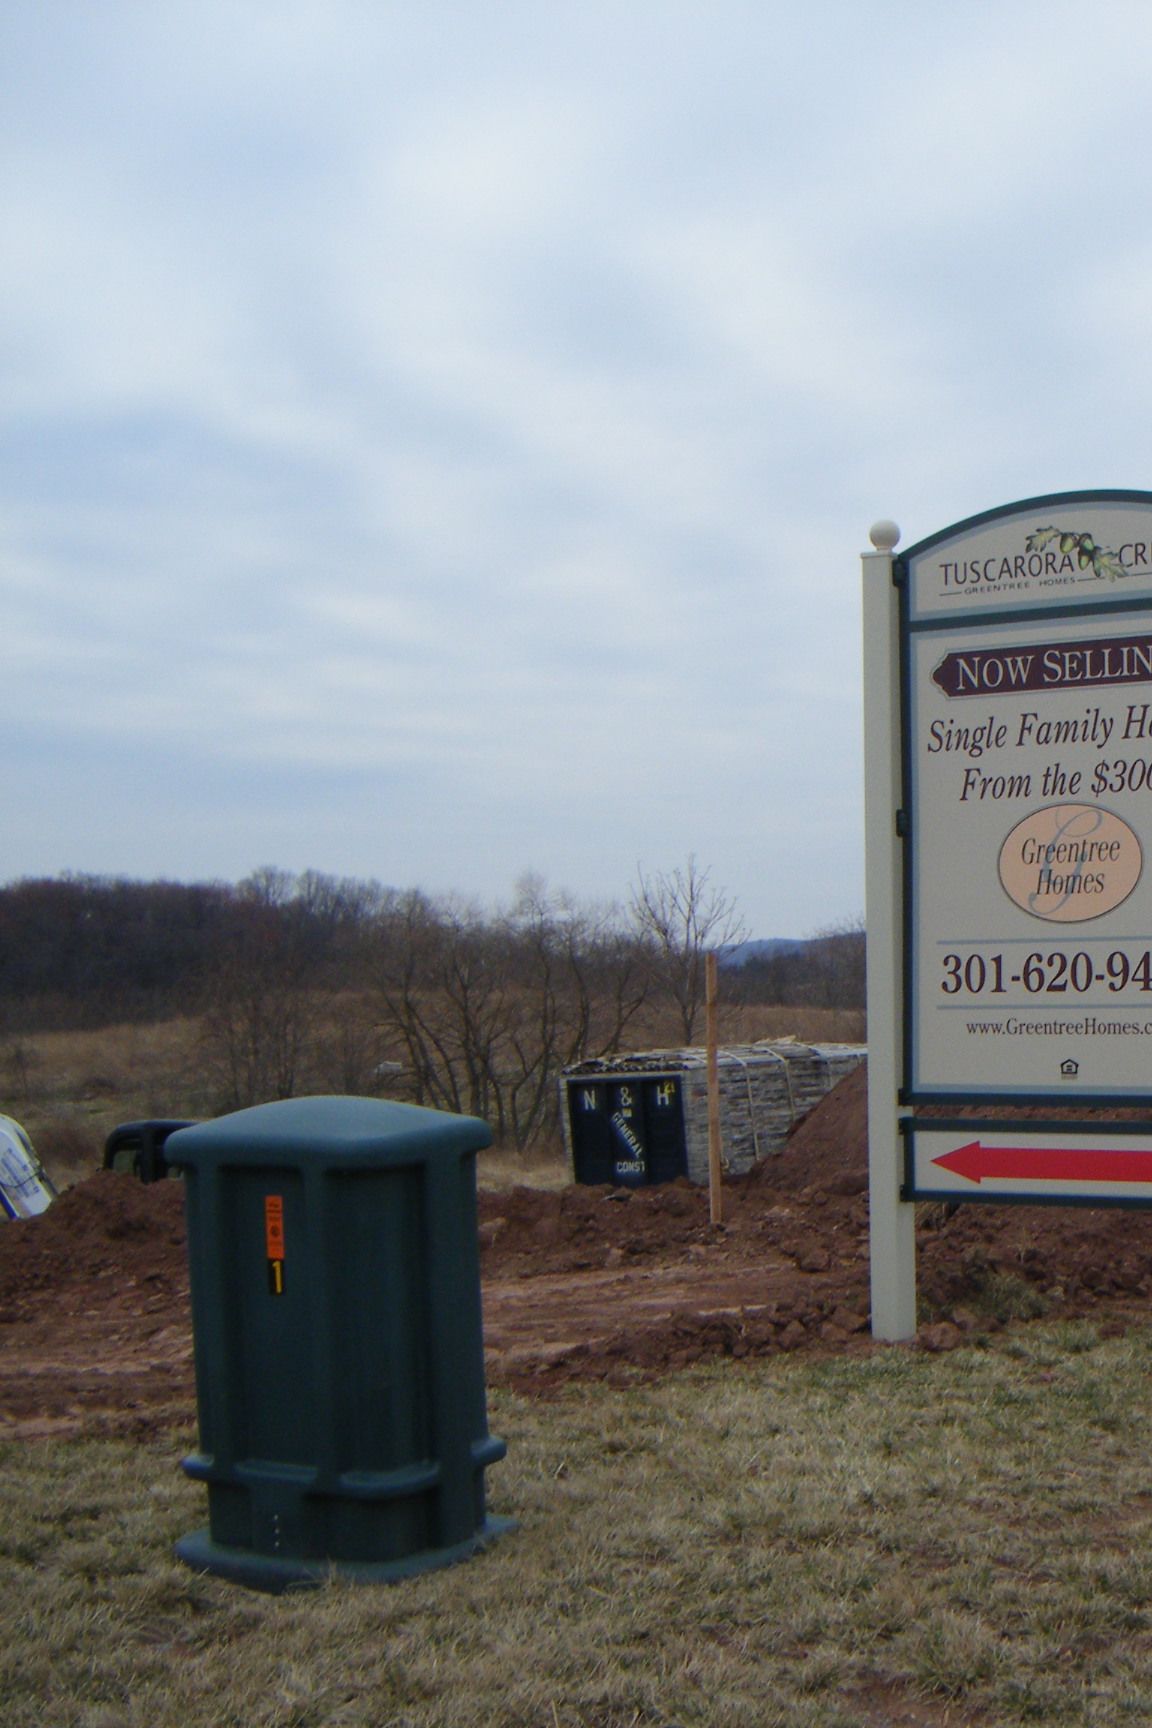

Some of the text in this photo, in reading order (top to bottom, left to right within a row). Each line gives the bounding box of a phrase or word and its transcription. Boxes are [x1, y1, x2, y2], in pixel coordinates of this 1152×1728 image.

[939, 553, 1075, 587] TUSCARORA
[964, 577, 1076, 595] GREENTREE HOMES
[957, 654, 1034, 690] NOW
[927, 716, 1007, 758] Single
[1016, 708, 1113, 748] Family
[960, 768, 1031, 800] From
[1042, 763, 1082, 796] the
[1021, 838, 1121, 865] Greentree
[1036, 869, 1105, 895] Homes
[583, 1089, 596, 1110] N
[620, 1086, 633, 1106] &
[612, 1111, 643, 1159] GENERAL
